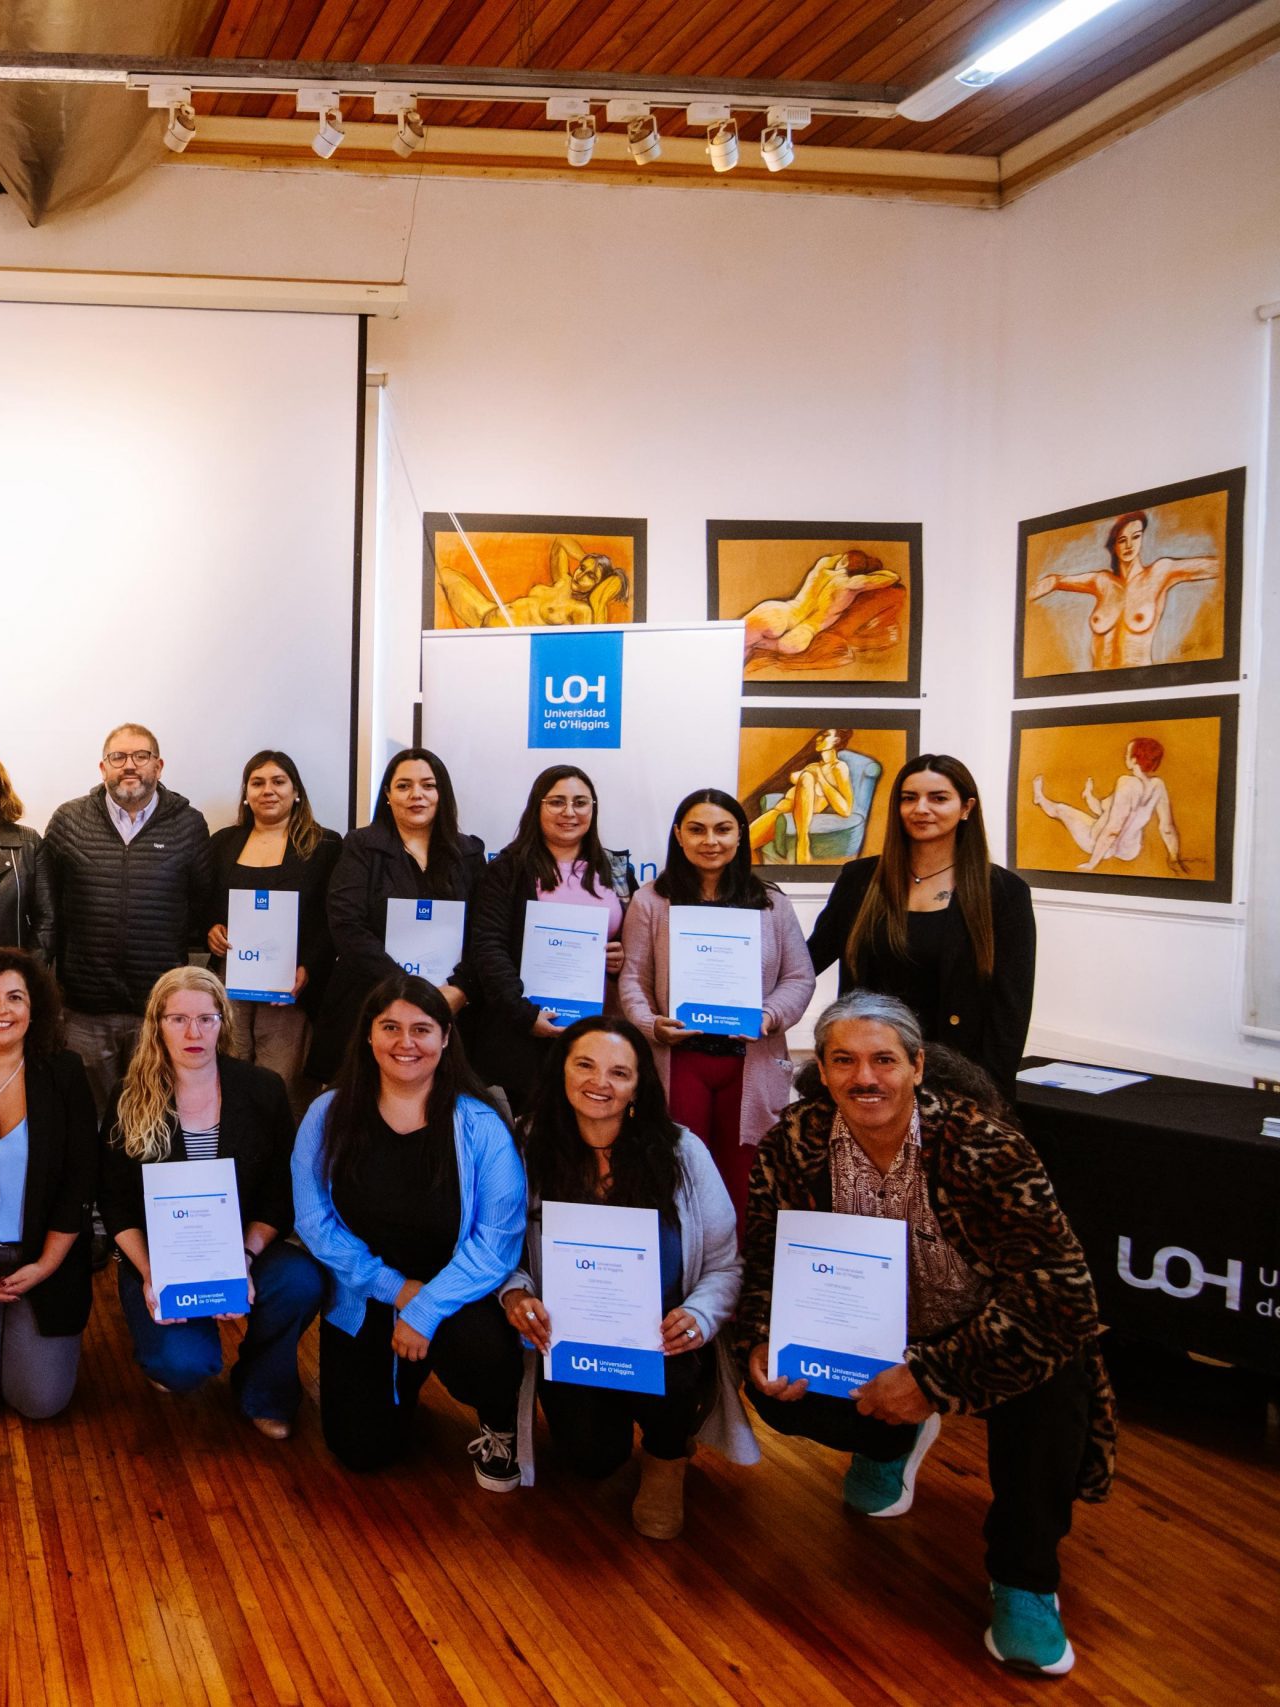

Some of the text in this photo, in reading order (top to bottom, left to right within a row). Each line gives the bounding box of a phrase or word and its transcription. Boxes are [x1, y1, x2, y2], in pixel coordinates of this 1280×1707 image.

[545, 675, 606, 703] UOH
[544, 708, 606, 718] Universidad
[543, 720, 610, 731] de O'Higgins
[1117, 1235, 1243, 1311] UOH
[571, 1356, 598, 1372] UOH
[800, 1360, 830, 1380] UOH
